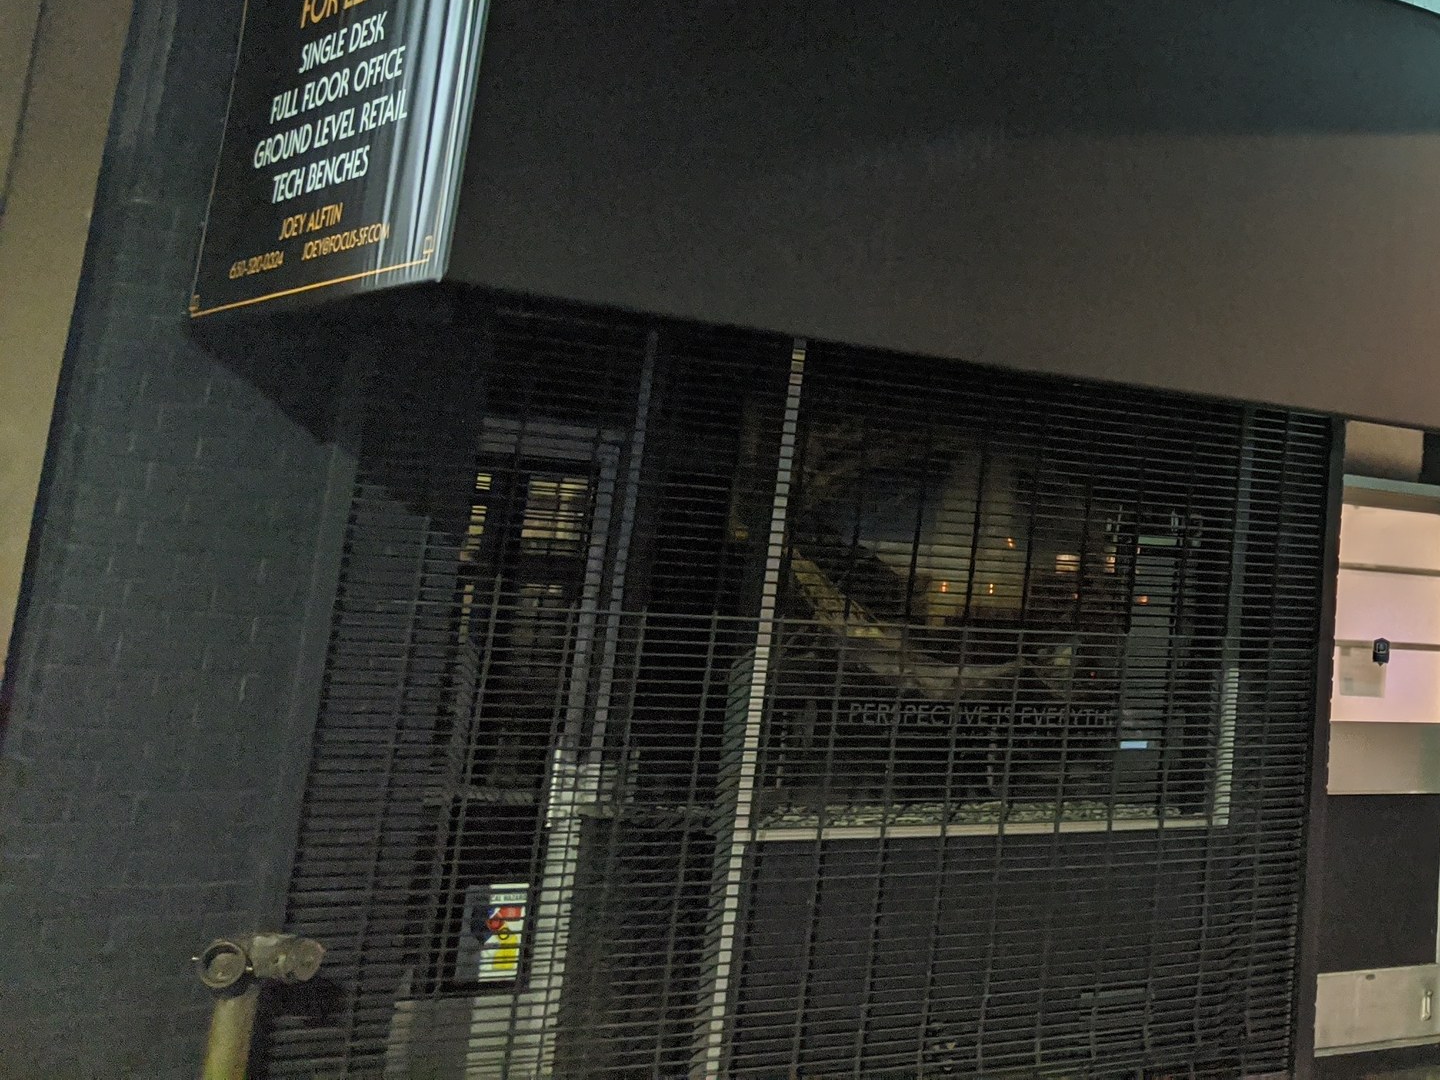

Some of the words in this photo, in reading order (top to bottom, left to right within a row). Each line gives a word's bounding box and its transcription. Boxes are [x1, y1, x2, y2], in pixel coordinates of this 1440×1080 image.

[299, 27, 348, 74] SINGLE
[349, 10, 388, 53] DESK
[269, 88, 298, 125] FULL
[301, 68, 350, 112] FLOOR
[354, 45, 406, 92] OFFICE
[254, 123, 312, 169] GROUND
[313, 108, 355, 149] LEVEL
[359, 89, 408, 134] RETAIL
[272, 167, 305, 204] TECH
[306, 145, 370, 194] BENCHES
[279, 212, 307, 241] JOEY
